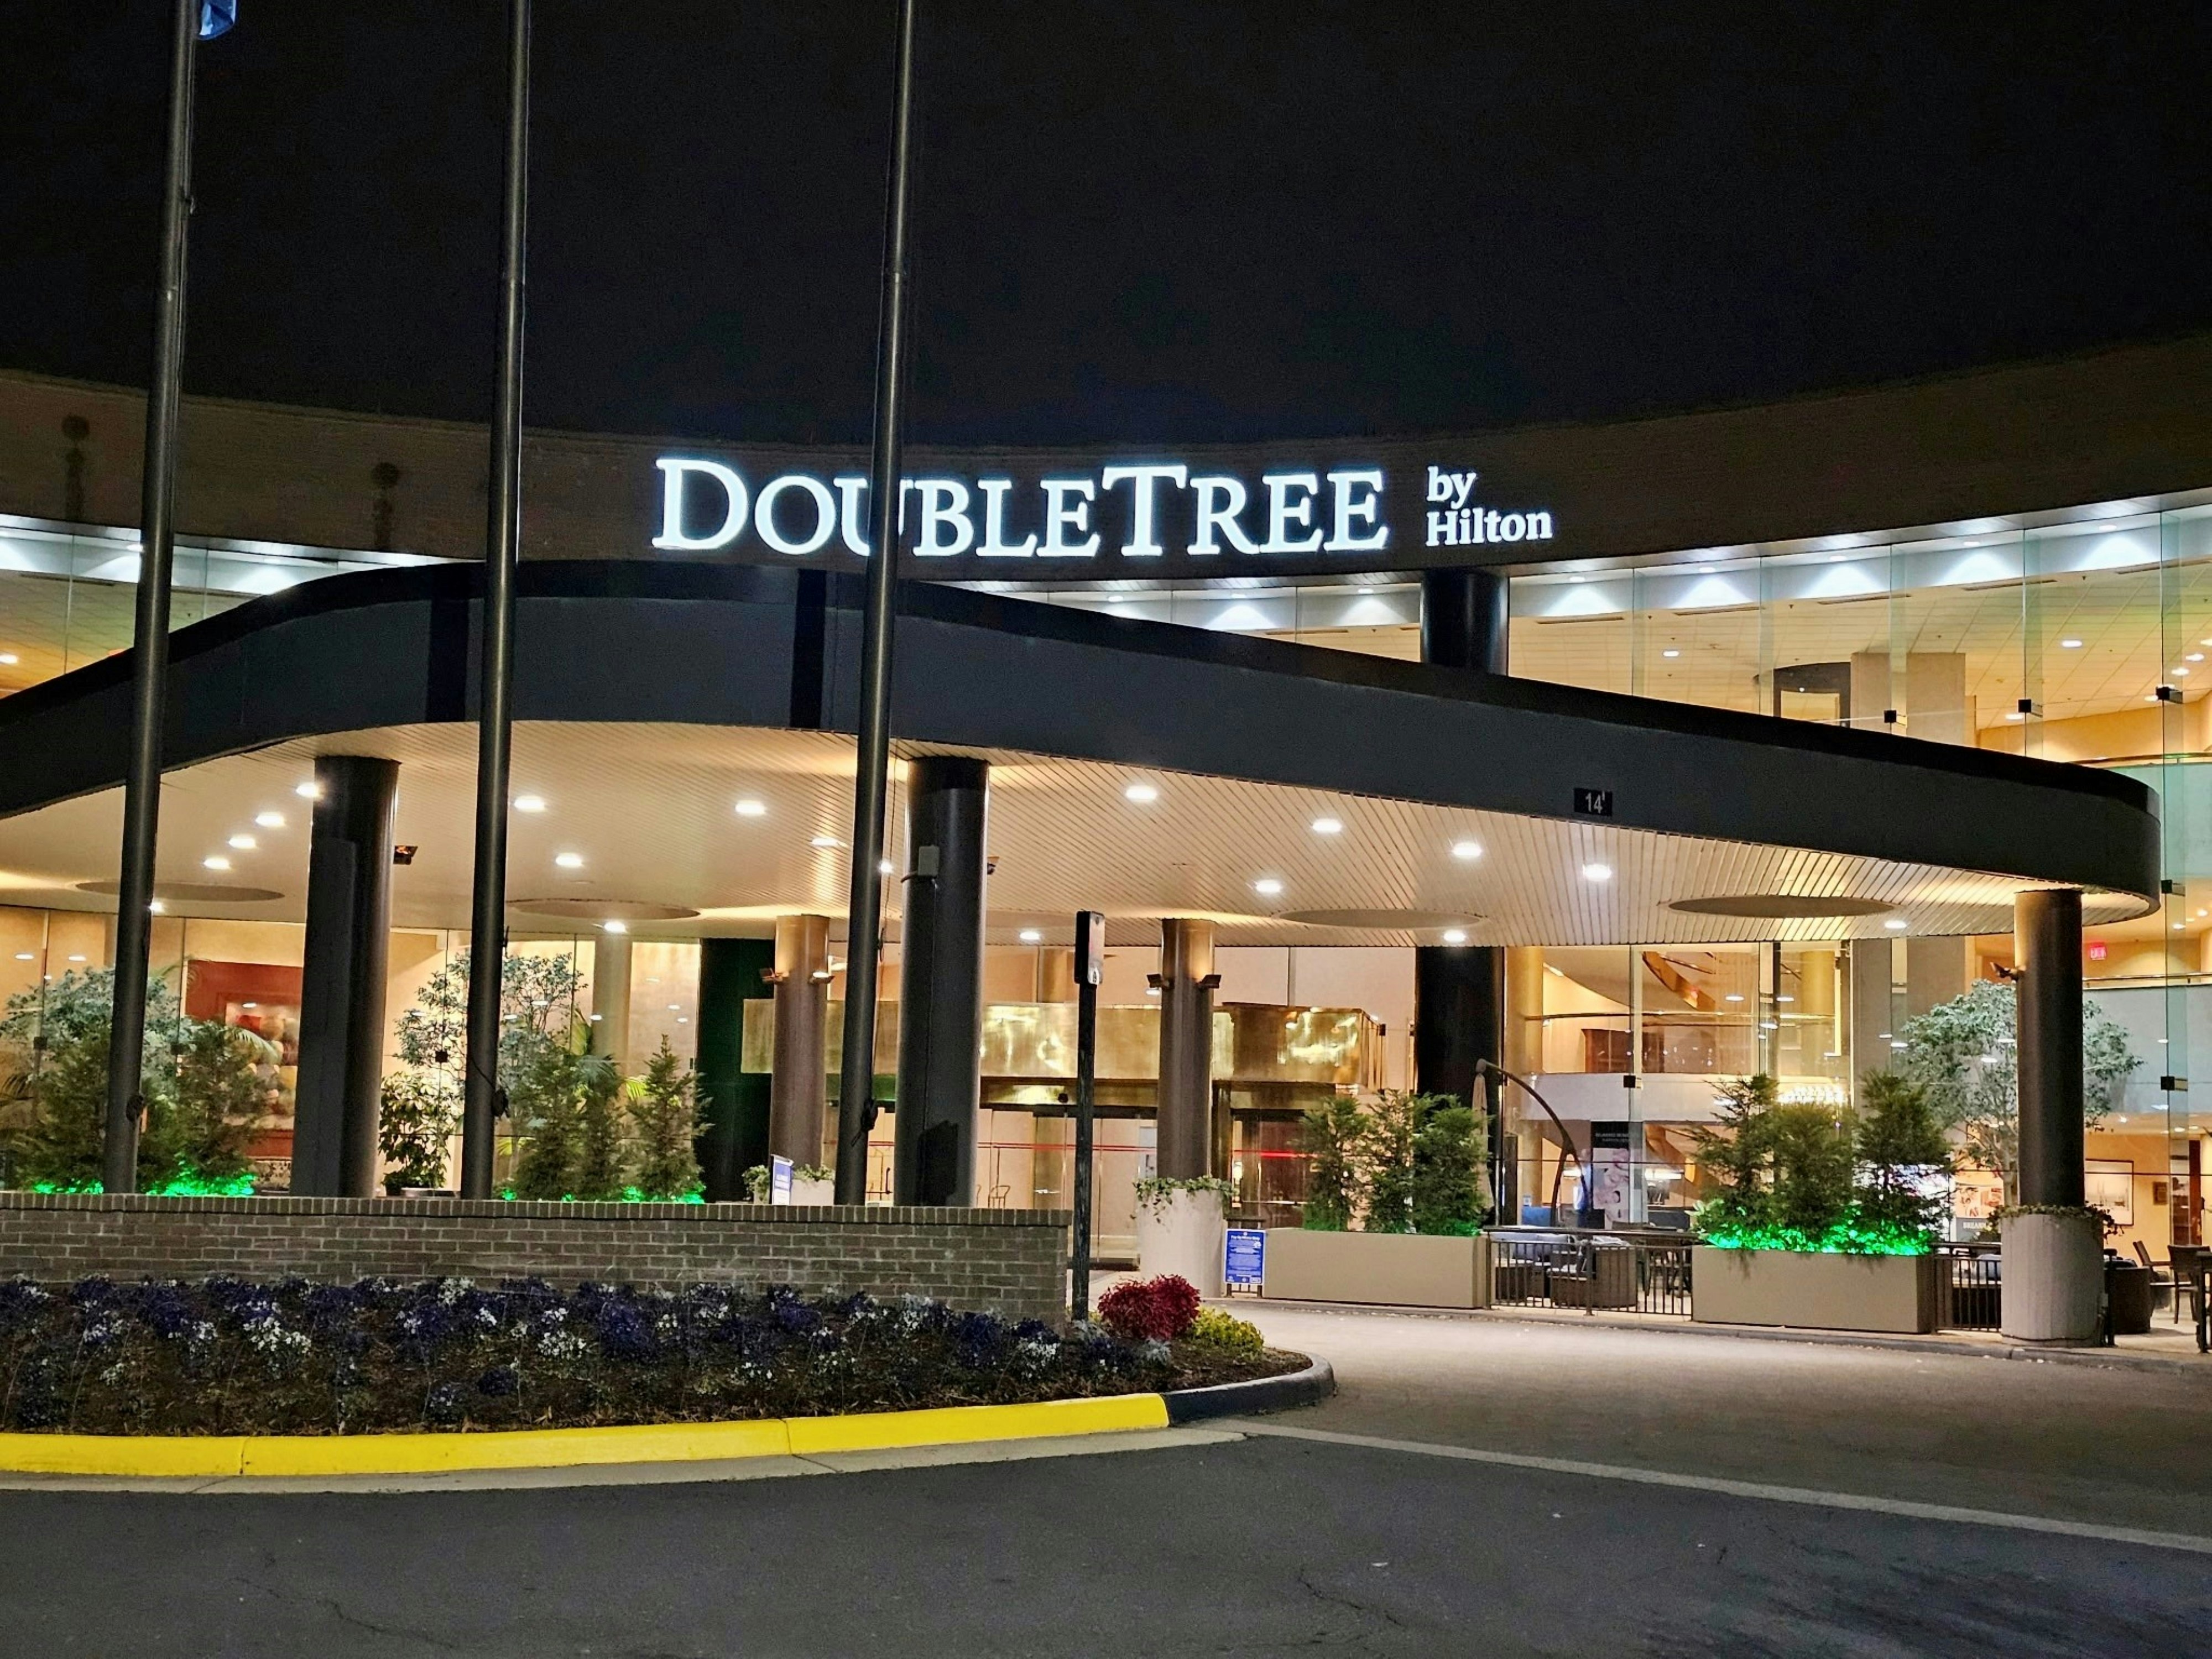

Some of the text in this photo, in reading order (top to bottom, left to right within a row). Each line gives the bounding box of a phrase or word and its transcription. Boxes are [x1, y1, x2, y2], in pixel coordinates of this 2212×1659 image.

[651, 457, 1390, 557] DOUBLETREE
[1426, 466, 1477, 510] by
[1426, 507, 1553, 547] Hilton
